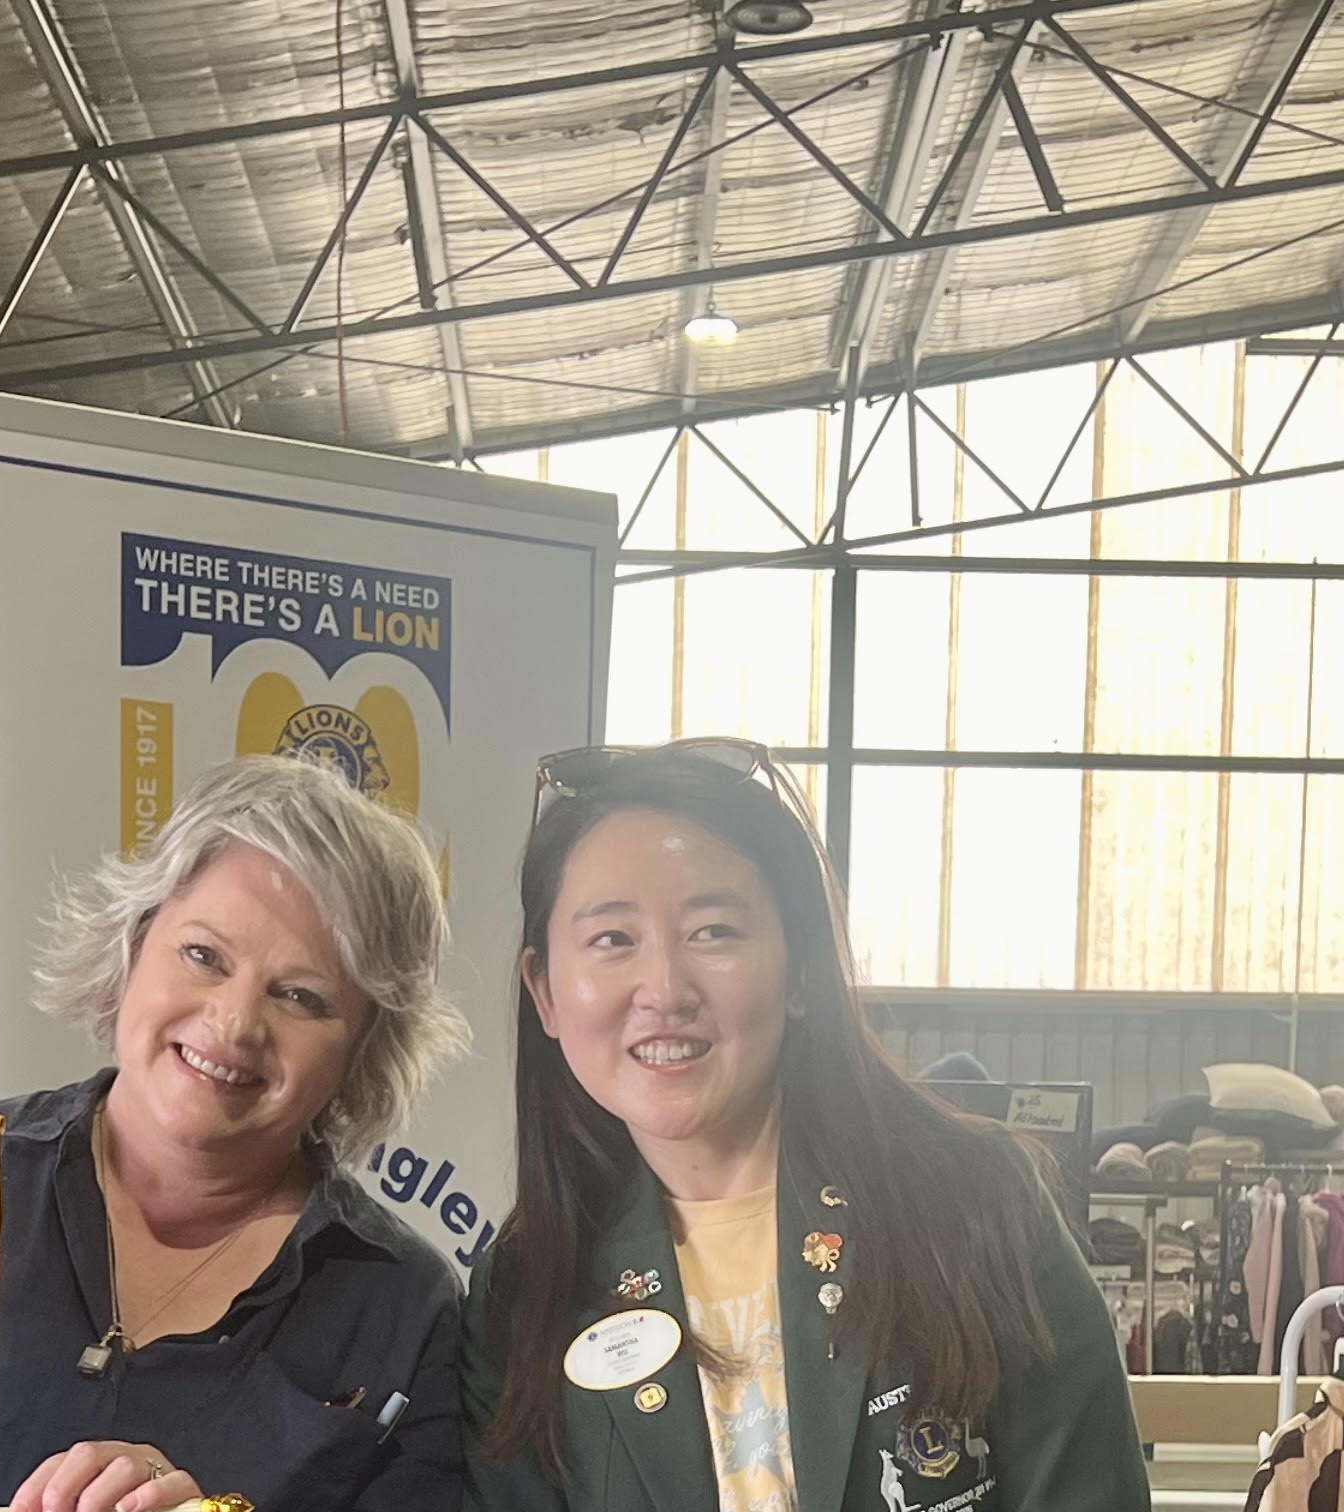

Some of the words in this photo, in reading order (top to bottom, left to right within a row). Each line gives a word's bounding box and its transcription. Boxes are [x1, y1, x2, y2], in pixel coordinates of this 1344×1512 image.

[135, 547, 230, 582] WHERE
[237, 561, 344, 598] THERE'S
[351, 578, 368, 600] A
[375, 581, 440, 610] NEED
[134, 578, 302, 632] THERE'S
[314, 603, 340, 637] A
[353, 606, 440, 651] LION
[136, 706, 157, 766] 1917
[295, 711, 365, 746] LIONS
[136, 777, 157, 861] INCE
